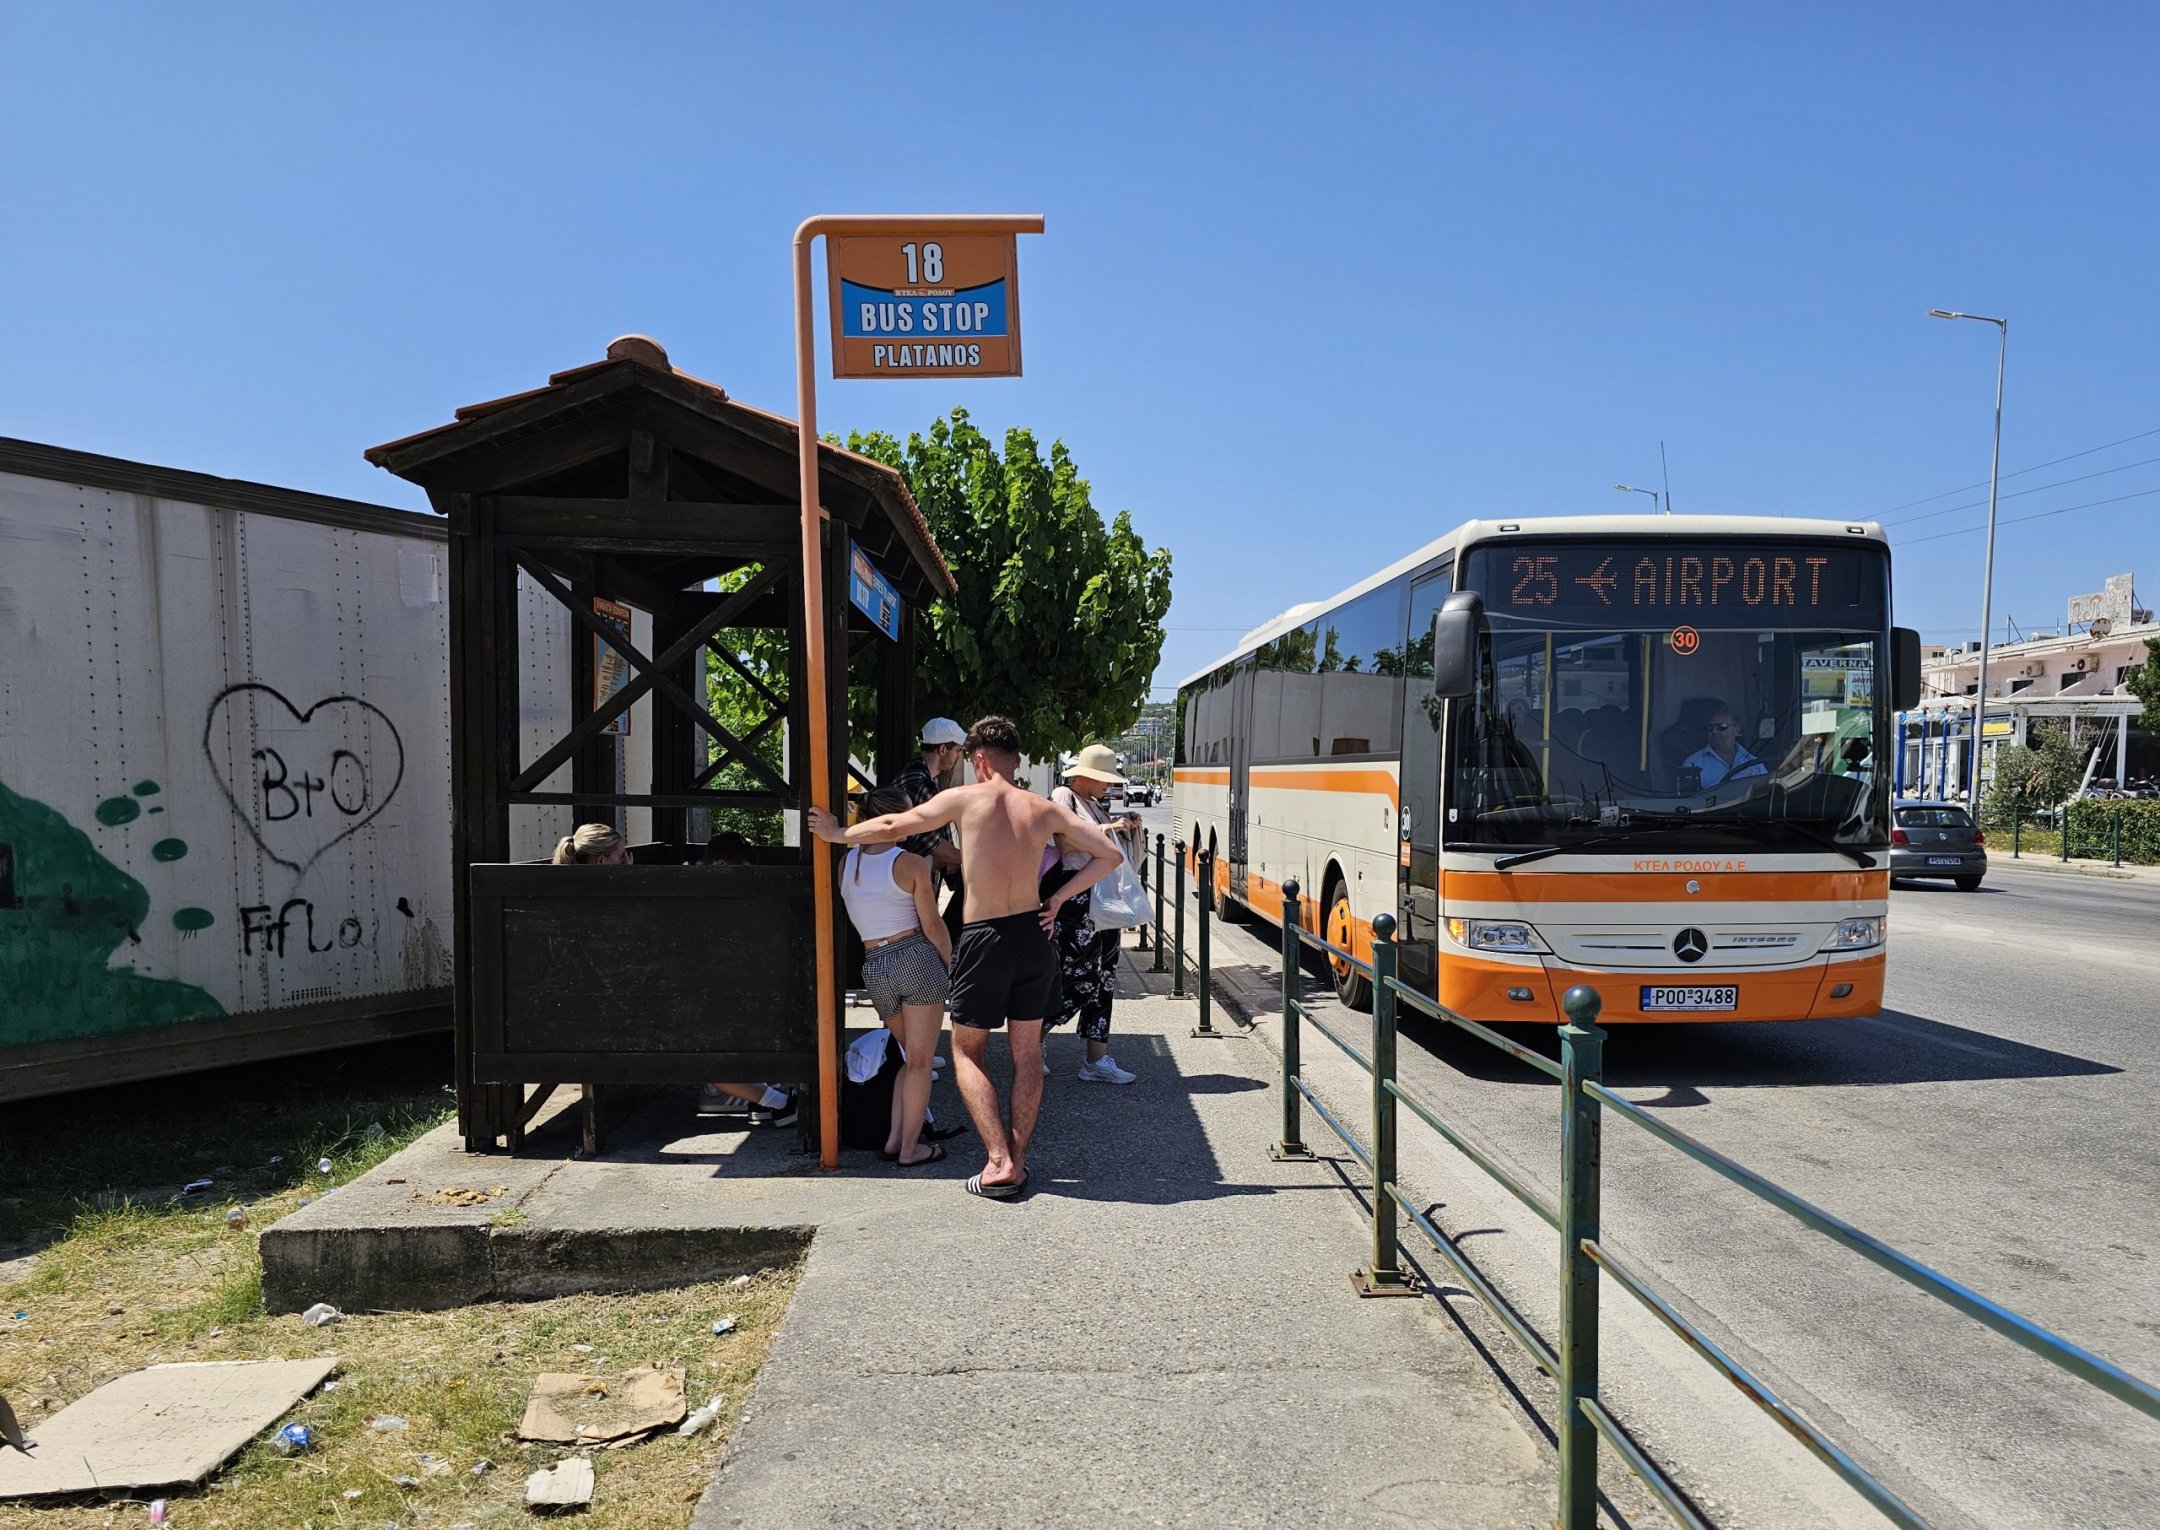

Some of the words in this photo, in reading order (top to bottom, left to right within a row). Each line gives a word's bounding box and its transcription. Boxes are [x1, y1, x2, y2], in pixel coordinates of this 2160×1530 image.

[901, 242, 944, 284] 18
[860, 302, 914, 333] BUS
[921, 302, 990, 332] STOP
[873, 343, 981, 368] PLATANOS
[1512, 556, 1559, 605] 25
[1633, 557, 1828, 605] AIRPORT
[1674, 631, 1696, 648] 30
[1802, 659, 1866, 668] TAVERNA
[1402, 813, 1410, 830] 30
[1634, 860, 1670, 872] ΚΤΕΛ
[1674, 860, 1720, 872] ΡΟΔΟΥ
